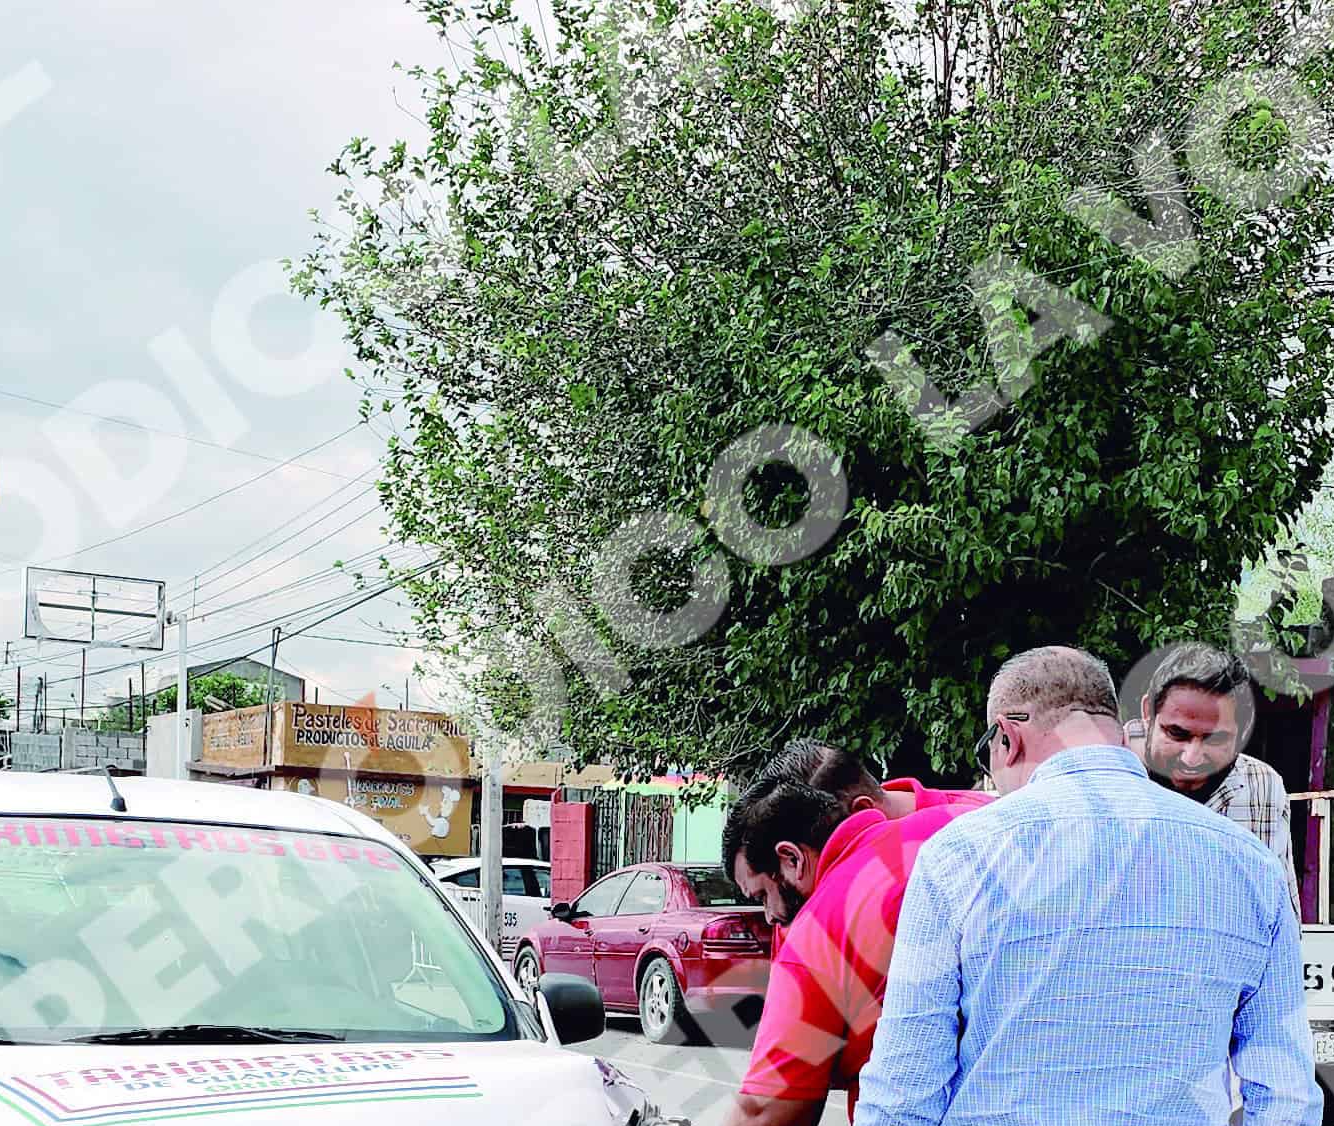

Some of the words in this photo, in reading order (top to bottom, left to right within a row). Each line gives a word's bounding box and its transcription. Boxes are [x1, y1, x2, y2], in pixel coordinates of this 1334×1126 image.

[292, 704, 361, 731] Pasteles
[364, 707, 380, 734] de
[296, 729, 366, 746] PRODUCTOS
[291, 838, 400, 872] GPE
[36, 1049, 455, 1089] TAXIMETROS
[123, 1080, 171, 1092] DE
[186, 1063, 403, 1086] GUADALUPE
[204, 1074, 349, 1092] ORIENTE
